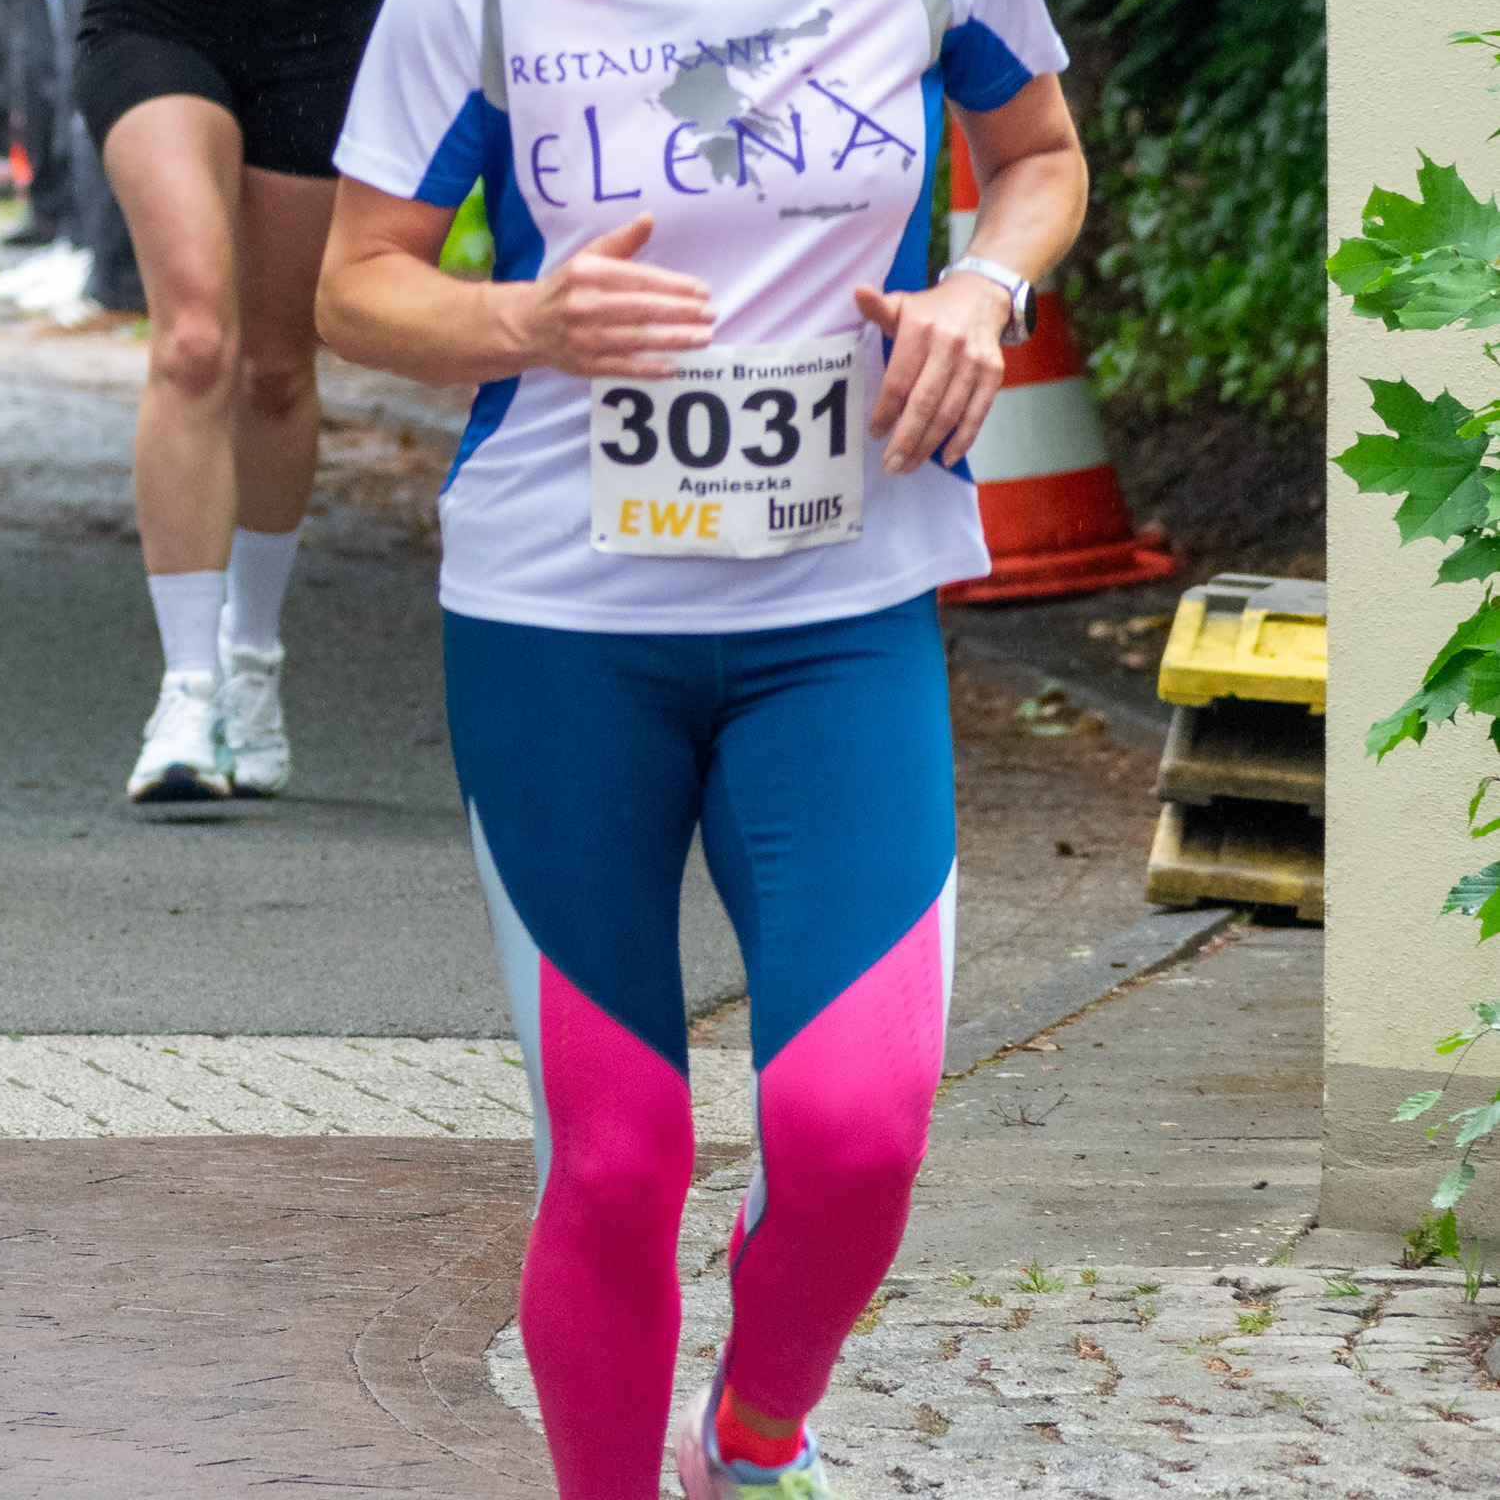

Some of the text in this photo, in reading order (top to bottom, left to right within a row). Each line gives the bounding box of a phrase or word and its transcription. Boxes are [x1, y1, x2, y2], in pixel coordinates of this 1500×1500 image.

[510, 34, 775, 85] RESTAURANT
[530, 78, 917, 208] ELENA
[732, 353, 853, 381] Brunnenlauf
[600, 378, 849, 470] 3031
[677, 476, 792, 497] Agnieszka
[618, 498, 723, 539] EWE
[768, 494, 843, 531] bruns
